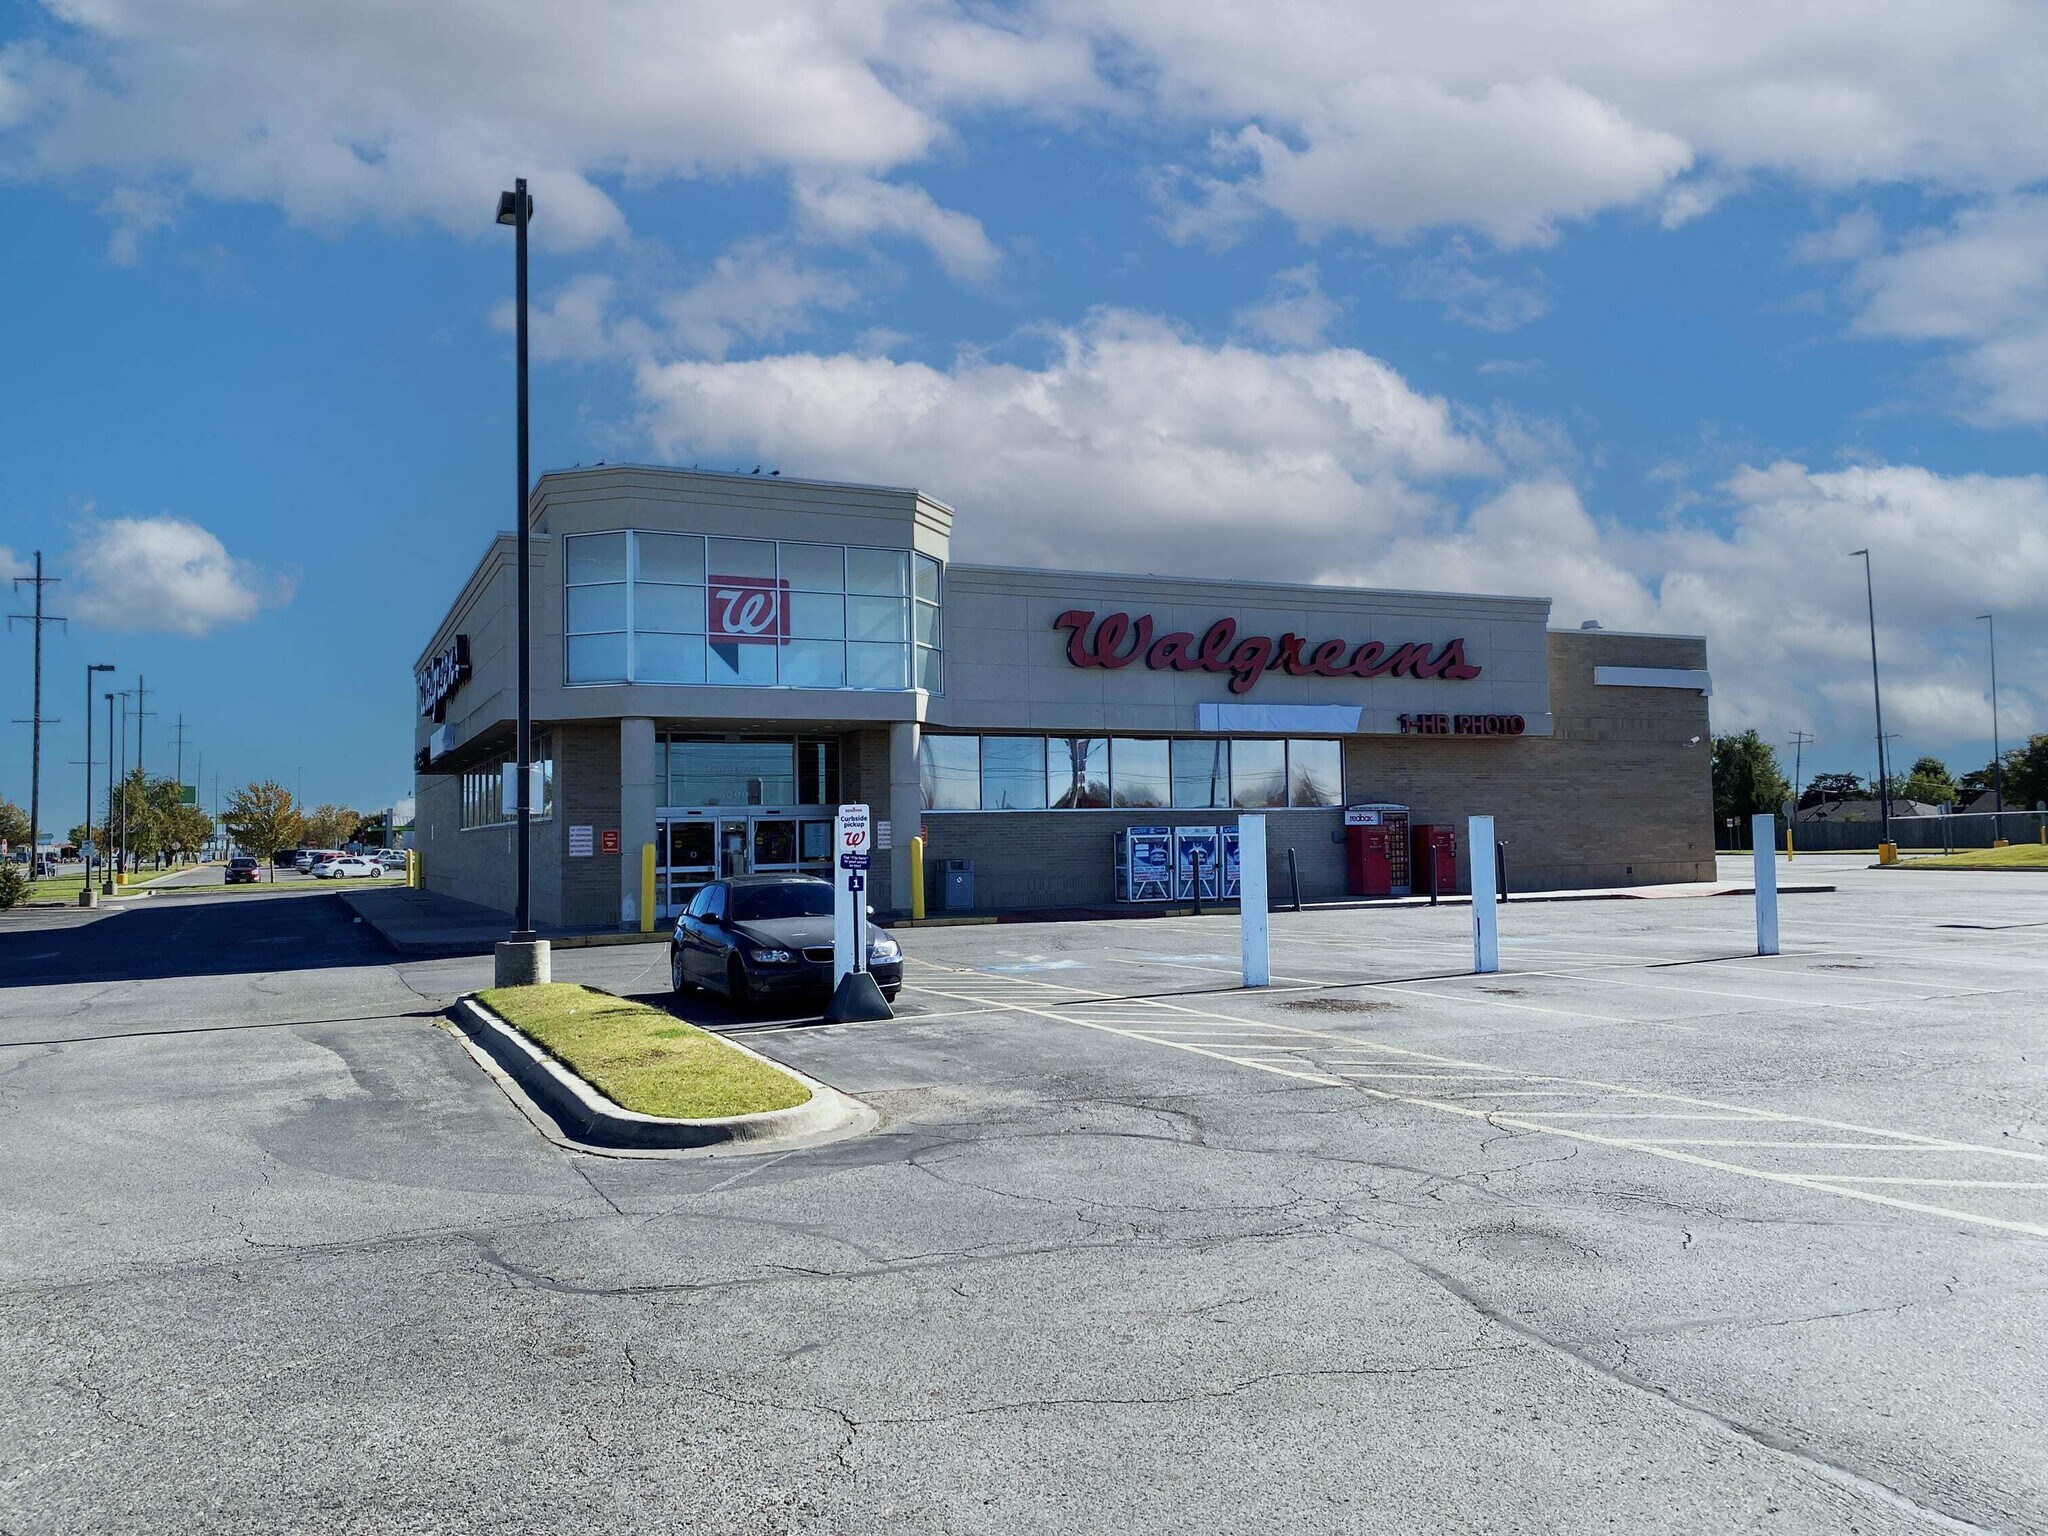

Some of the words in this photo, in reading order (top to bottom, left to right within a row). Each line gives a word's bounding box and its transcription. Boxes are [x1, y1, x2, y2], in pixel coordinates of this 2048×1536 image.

[1053, 610, 1482, 694] Walgreens
[1397, 713, 1450, 734] 1-HR
[1454, 714, 1525, 735] PHOTO
[853, 879, 859, 888] 1
